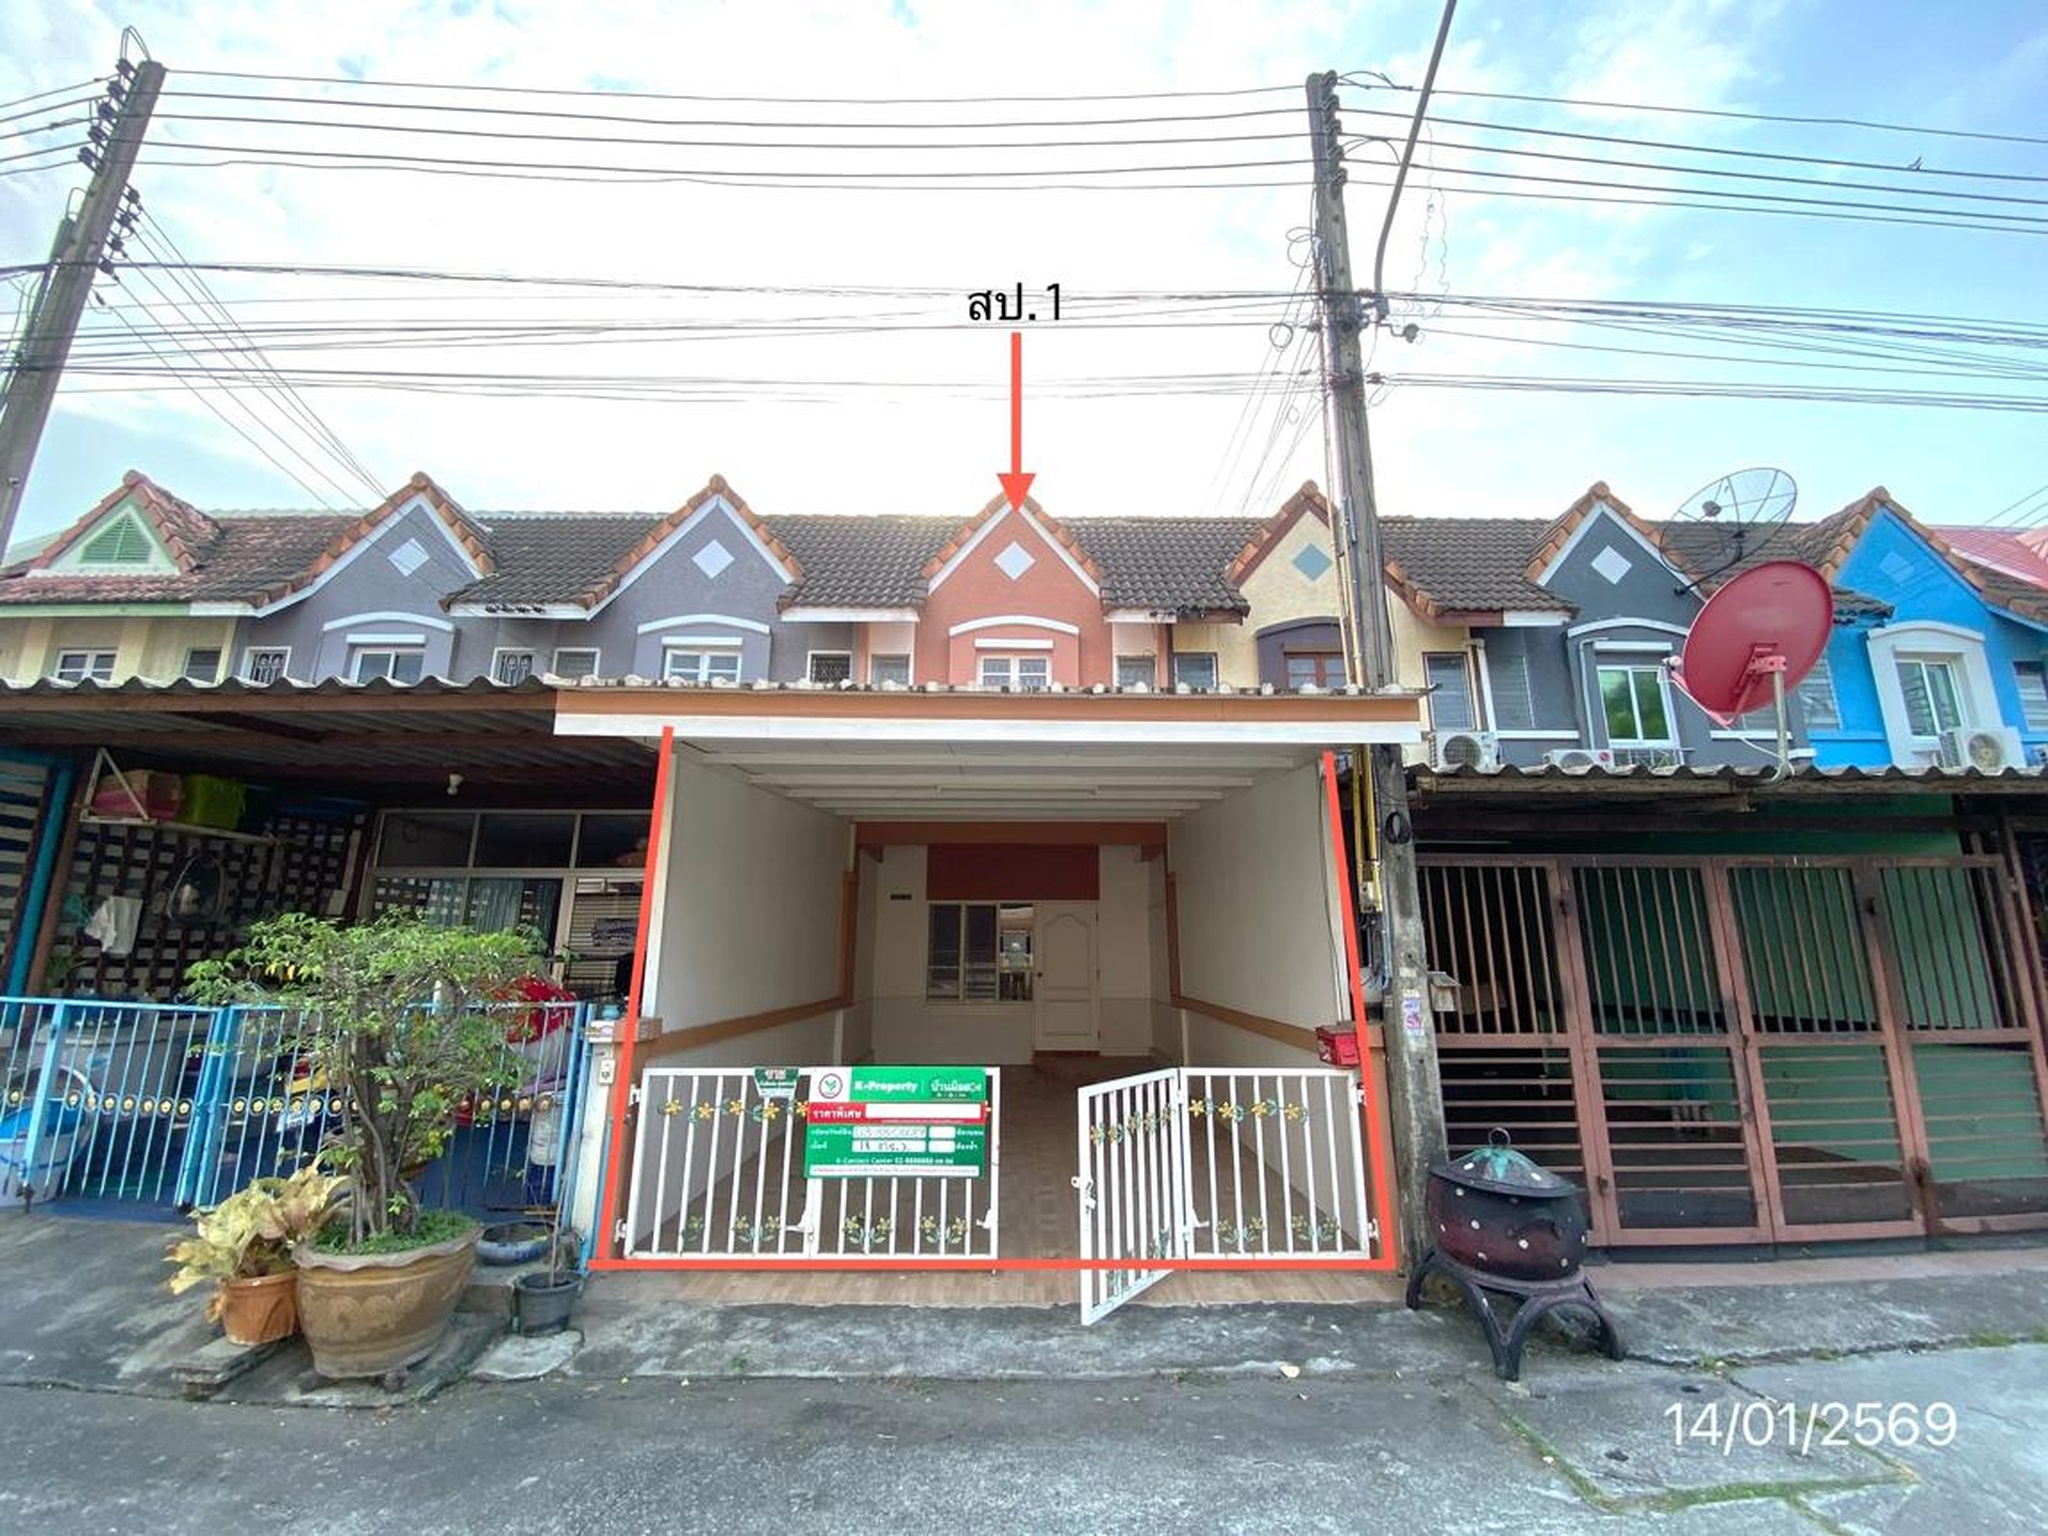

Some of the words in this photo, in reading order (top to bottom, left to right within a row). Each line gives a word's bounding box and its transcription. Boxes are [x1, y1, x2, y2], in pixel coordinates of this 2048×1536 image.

[854, 1080, 918, 1094] K-Property
[812, 1106, 862, 1119] ราคาพิเศษ
